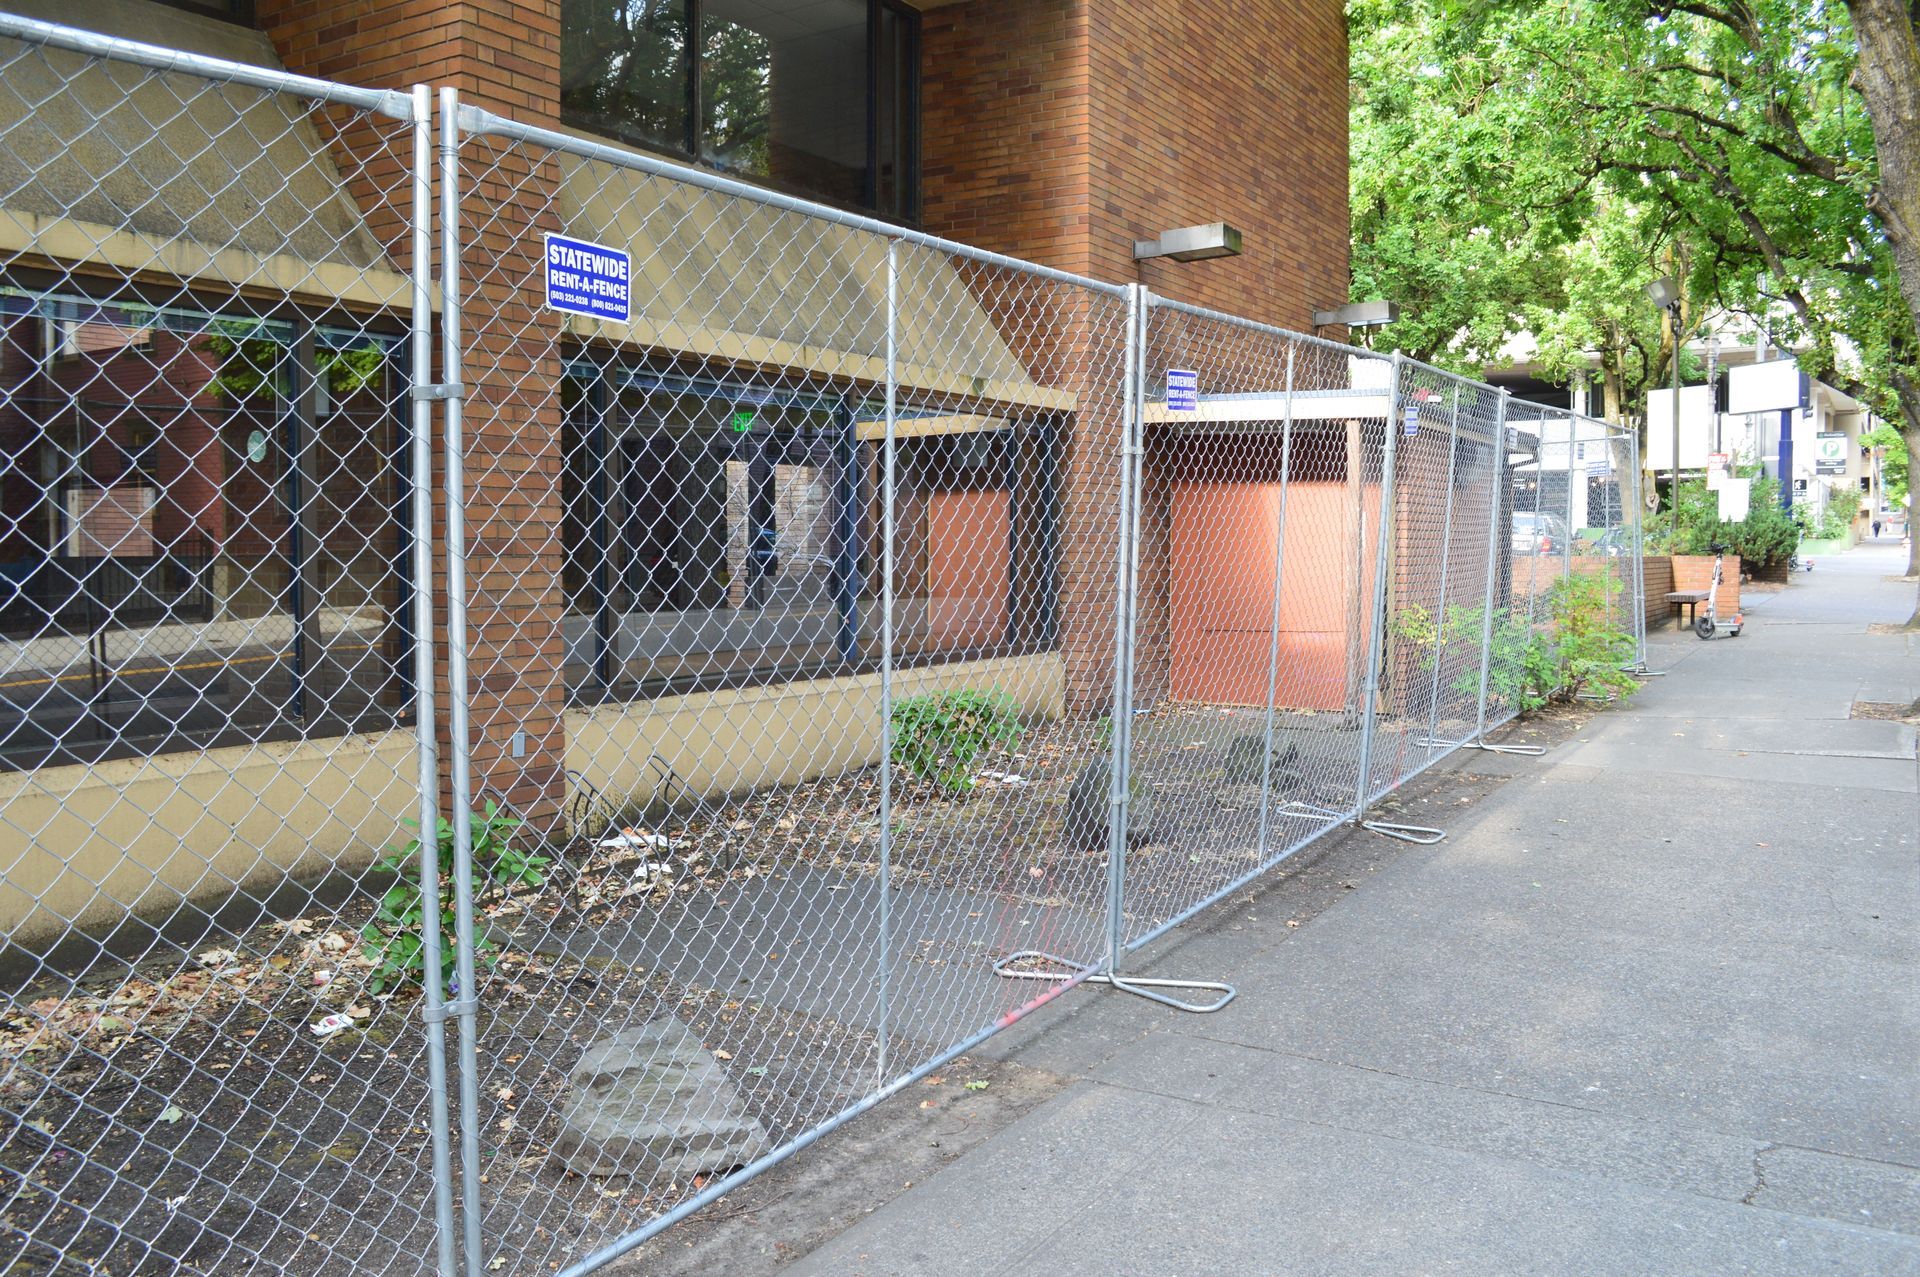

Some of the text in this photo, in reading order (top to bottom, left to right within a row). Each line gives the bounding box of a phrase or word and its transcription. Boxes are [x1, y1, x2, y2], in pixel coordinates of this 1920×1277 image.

[549, 244, 627, 280] STATEWIDE
[550, 269, 627, 300] RENT-A-FENCE
[550, 290, 565, 302] (503)
[1168, 375, 1196, 388] STATEWIDE
